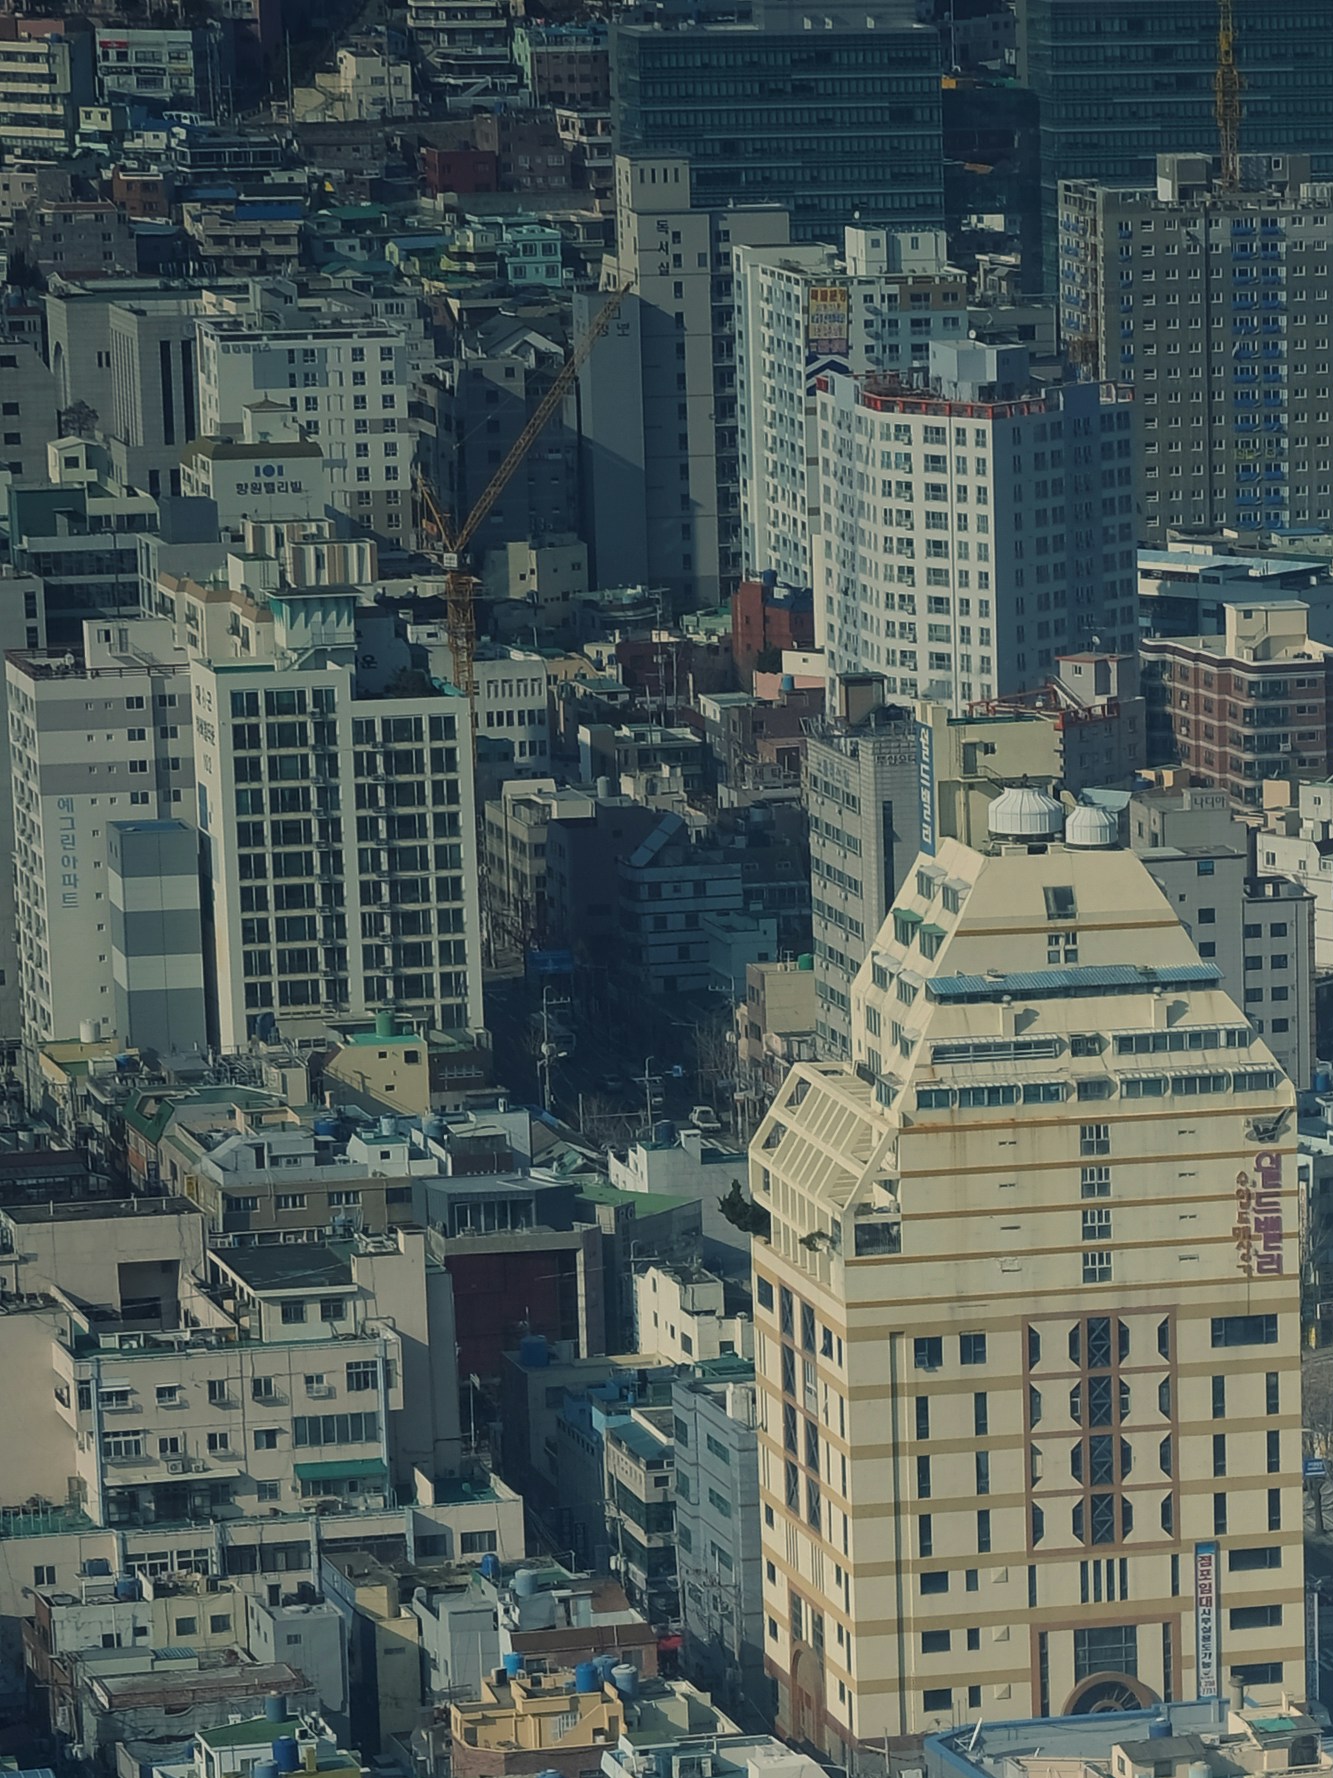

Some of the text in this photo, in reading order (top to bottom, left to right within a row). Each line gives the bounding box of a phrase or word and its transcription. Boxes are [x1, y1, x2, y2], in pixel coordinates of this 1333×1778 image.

[655, 219, 671, 276] 독서실
[1193, 796, 1226, 809] 나디아
[56, 796, 80, 910] 예그린아파트
